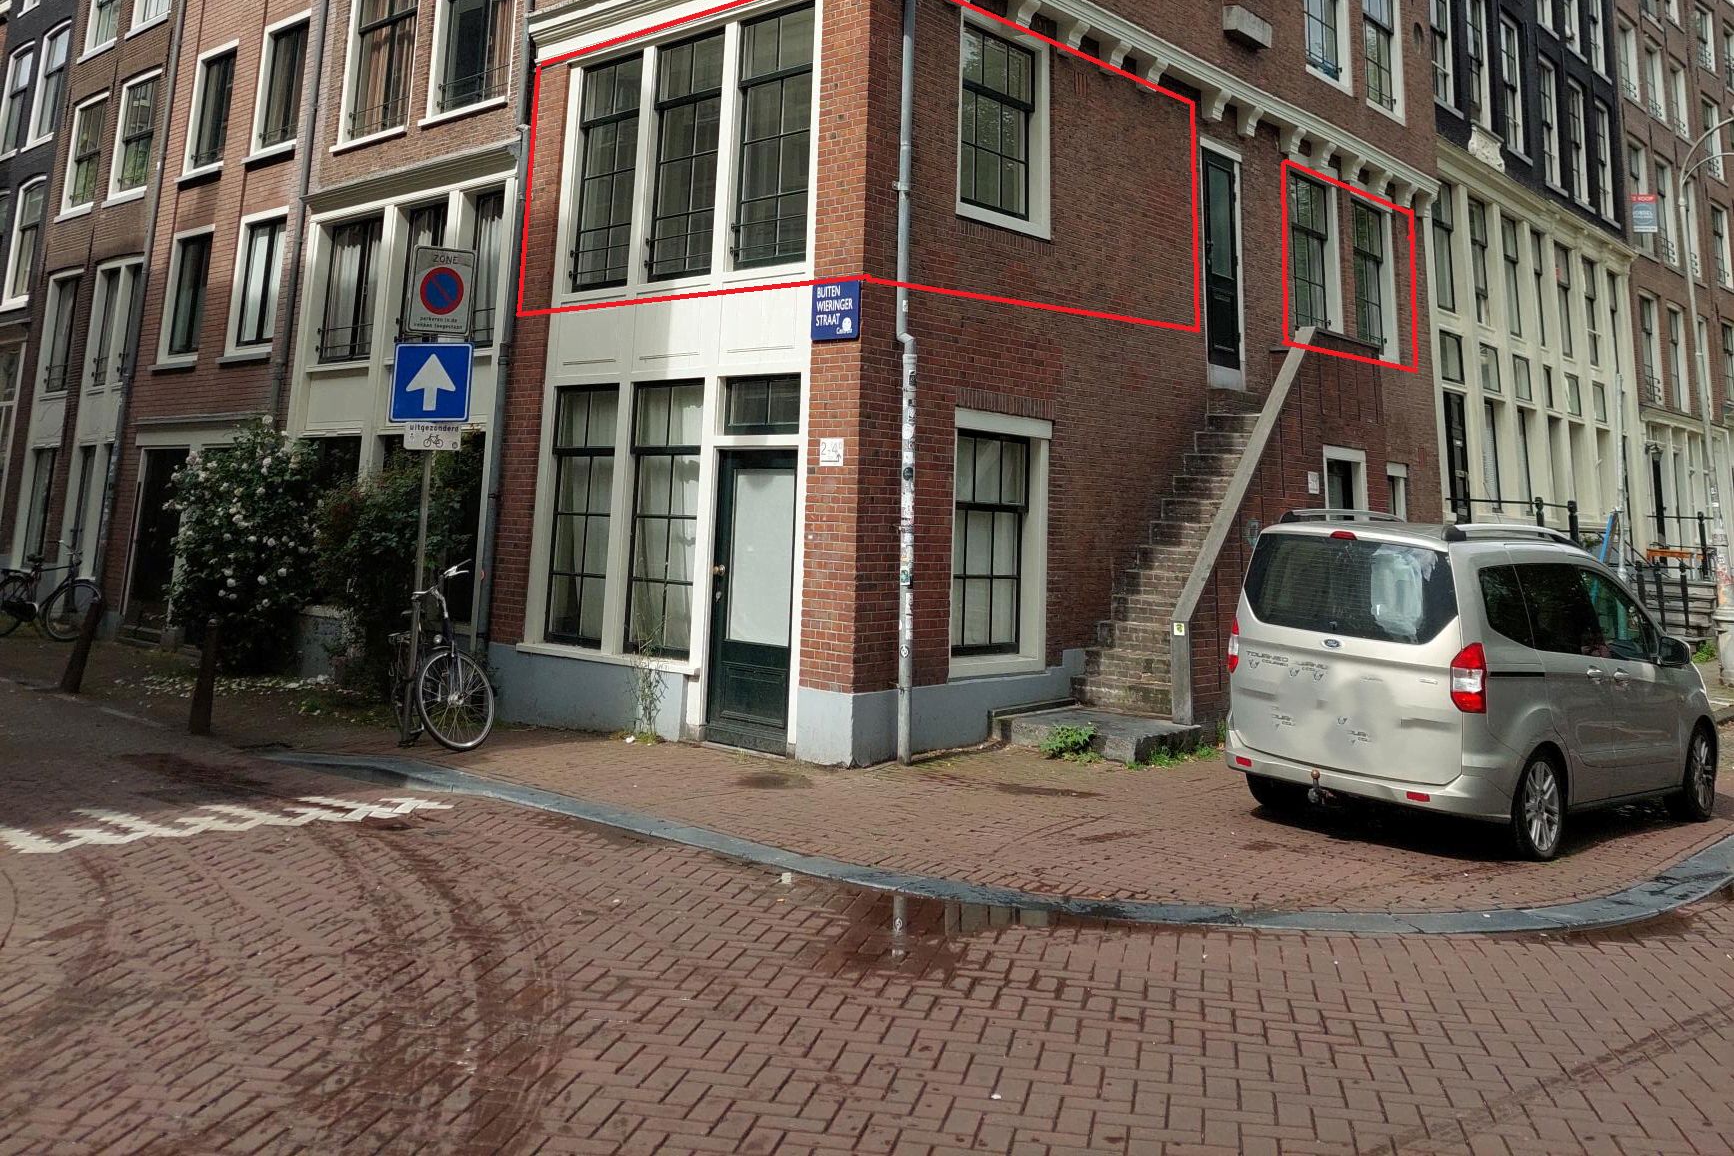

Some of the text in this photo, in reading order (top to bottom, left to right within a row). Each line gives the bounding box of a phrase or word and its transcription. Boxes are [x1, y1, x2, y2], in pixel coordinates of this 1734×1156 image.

[433, 255, 458, 265] ZONE
[816, 285, 841, 298] BUITEN
[816, 298, 853, 312] WIERINGER
[815, 313, 841, 326] STRAAT
[410, 424, 459, 432] uitgezonderd
[1246, 650, 1289, 663] TOURNEO
